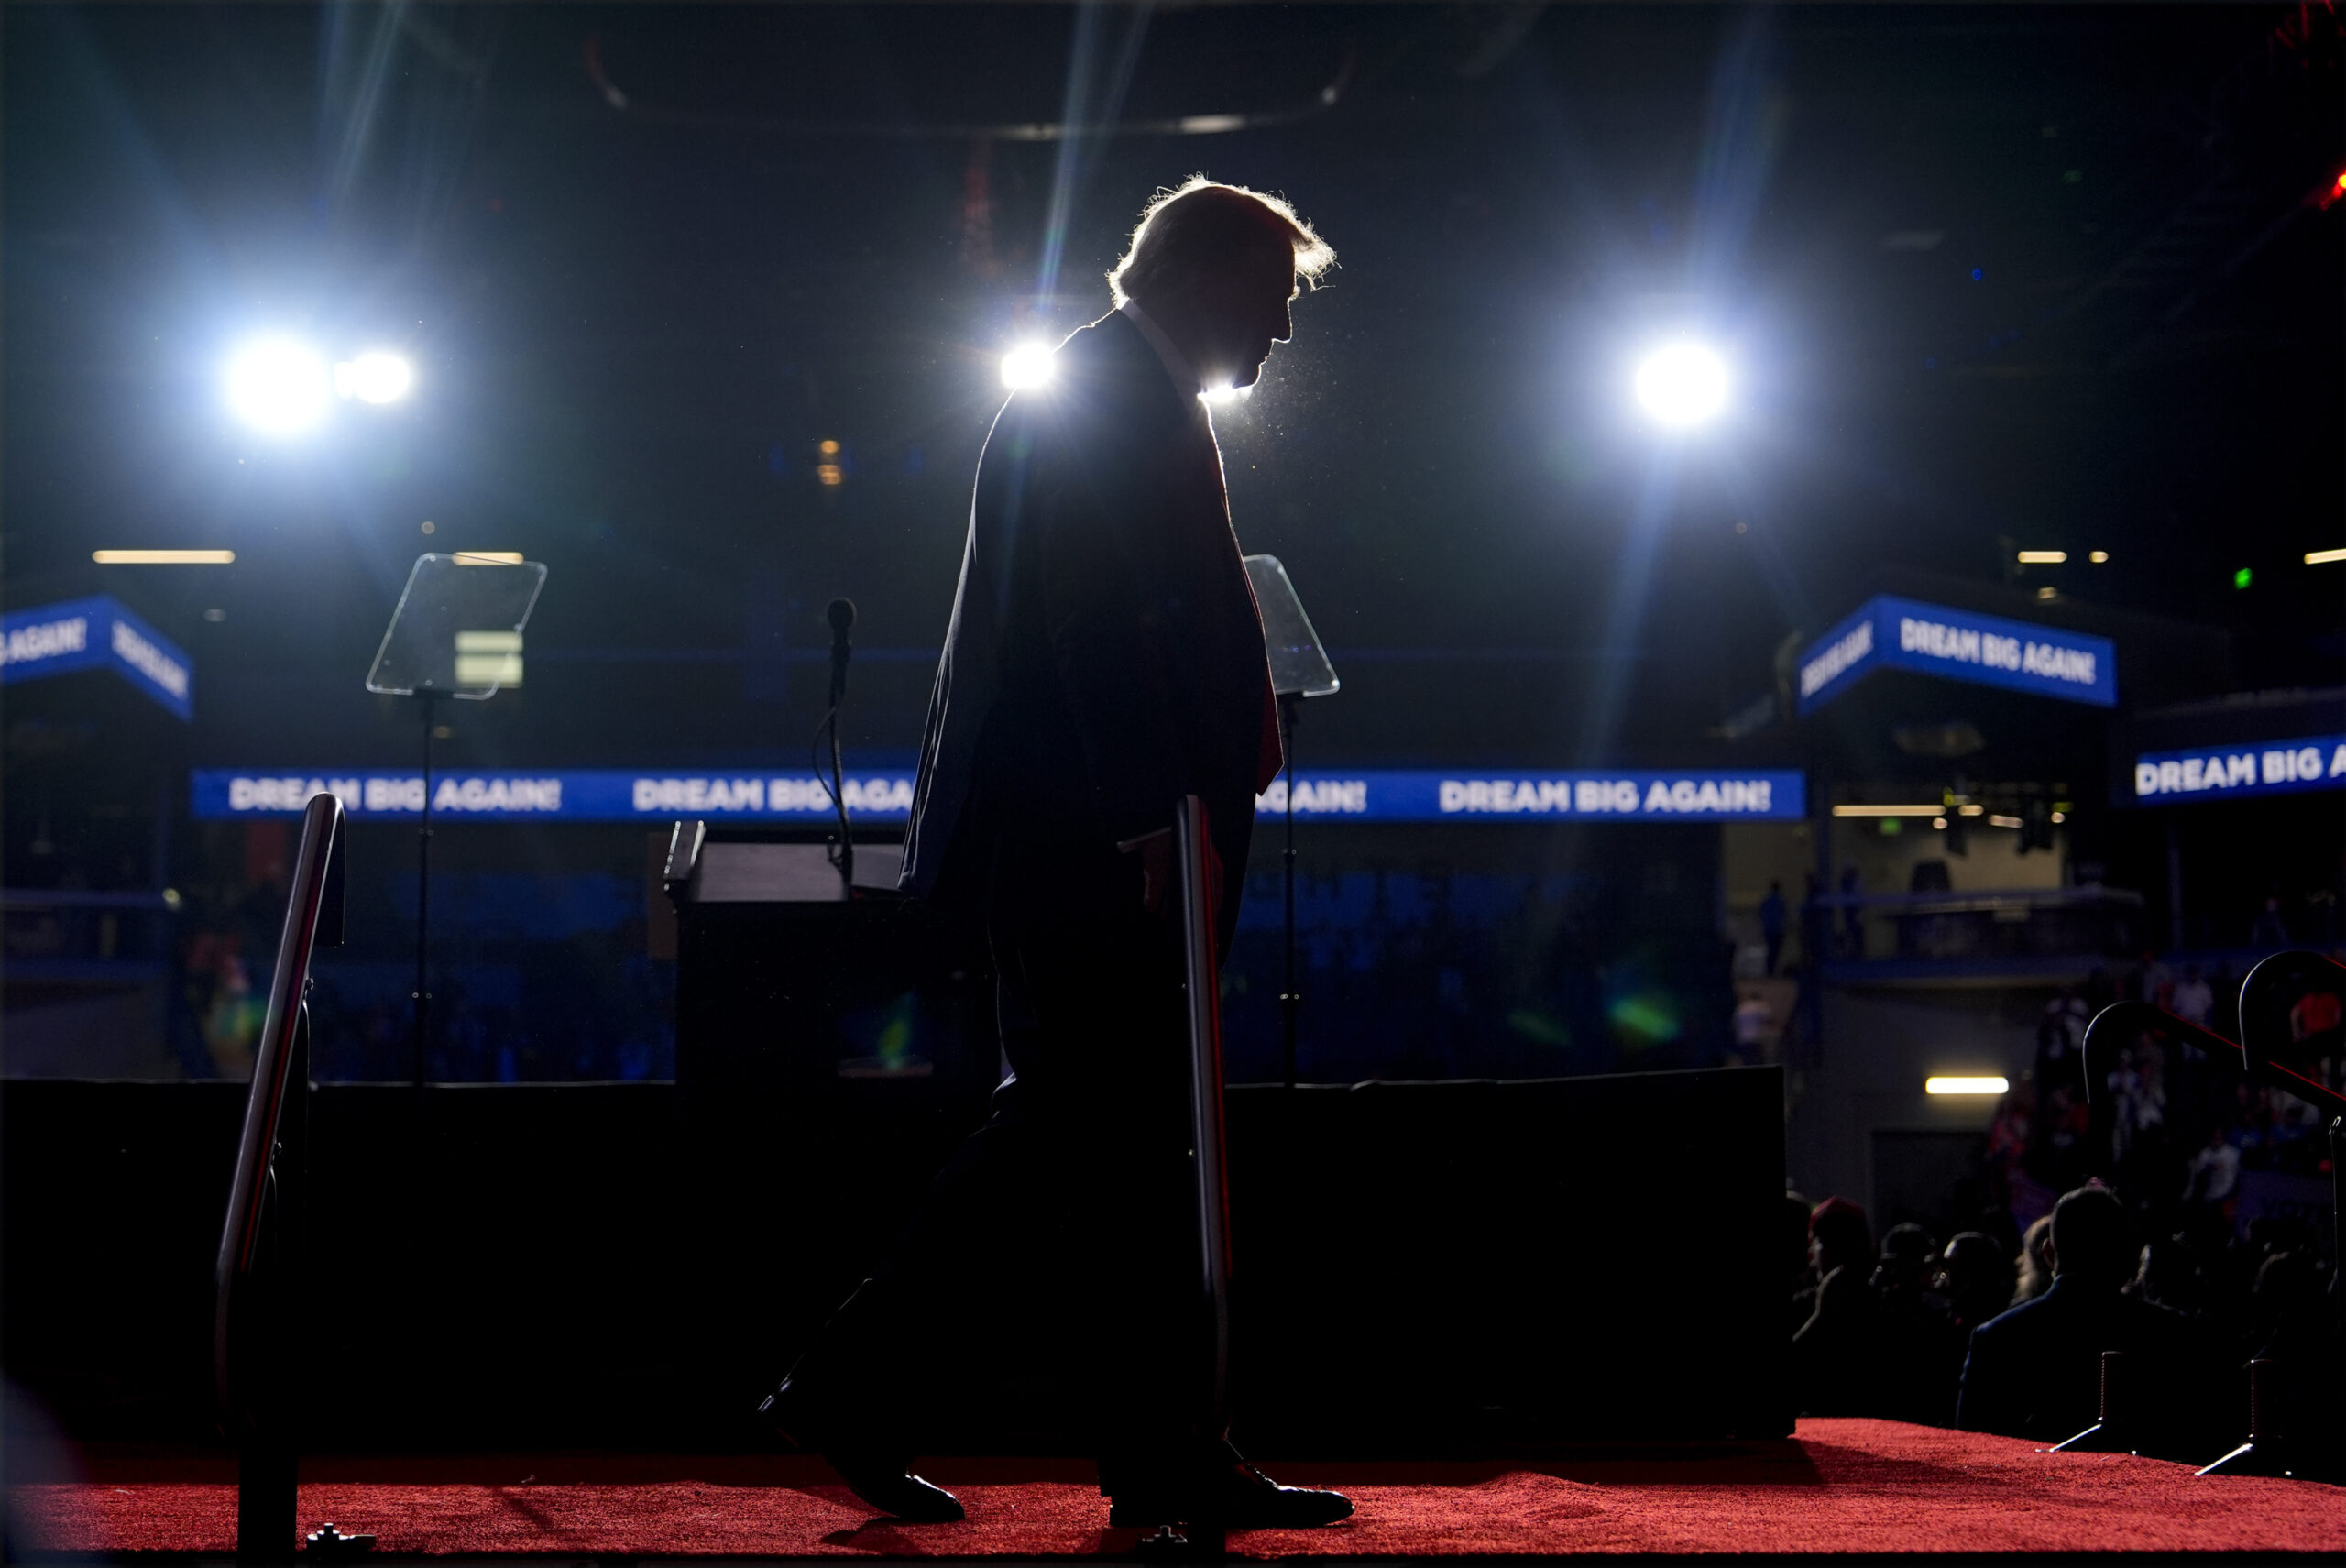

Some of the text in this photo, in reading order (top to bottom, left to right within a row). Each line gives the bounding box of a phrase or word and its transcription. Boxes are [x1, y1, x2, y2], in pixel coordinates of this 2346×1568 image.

[1900, 617, 1981, 664] DREAM
[1981, 632, 2021, 671] BIG
[2135, 753, 2257, 796] DREAM
[2261, 747, 2324, 784] BIG
[364, 777, 426, 812] BIG
[432, 777, 563, 812] AGAIN!
[632, 777, 765, 812] DREAM
[767, 777, 835, 812] BIG
[1439, 779, 1772, 813] DREAM BIG AGAIN!
